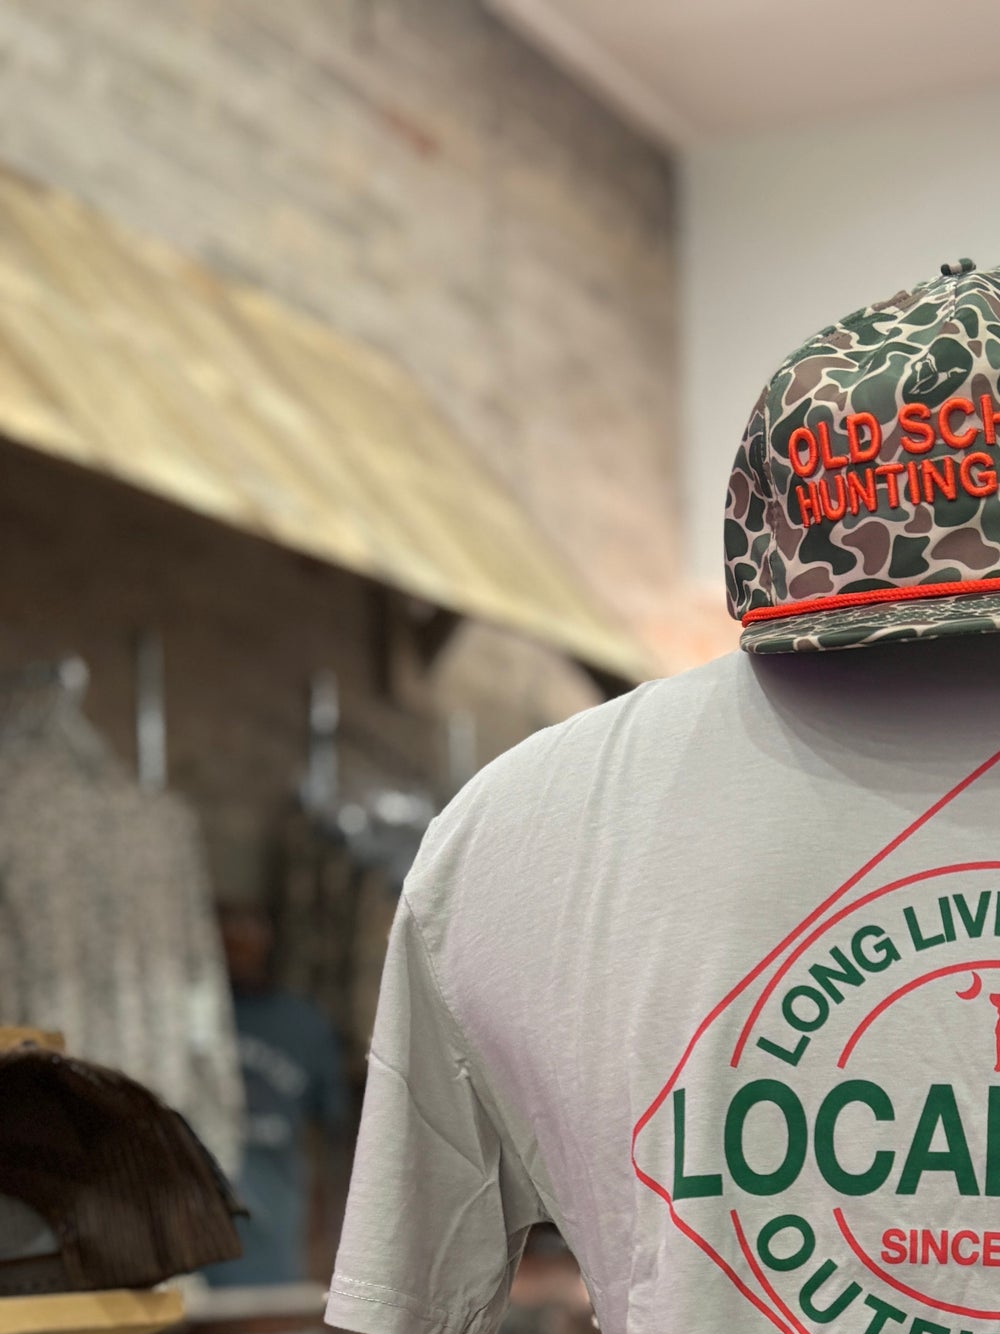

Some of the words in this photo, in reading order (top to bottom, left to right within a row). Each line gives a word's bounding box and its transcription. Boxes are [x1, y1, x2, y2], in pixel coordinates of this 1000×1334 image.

[788, 412, 882, 478] OLD
[795, 451, 998, 528] HUNTING
[756, 924, 901, 1066] LONG
